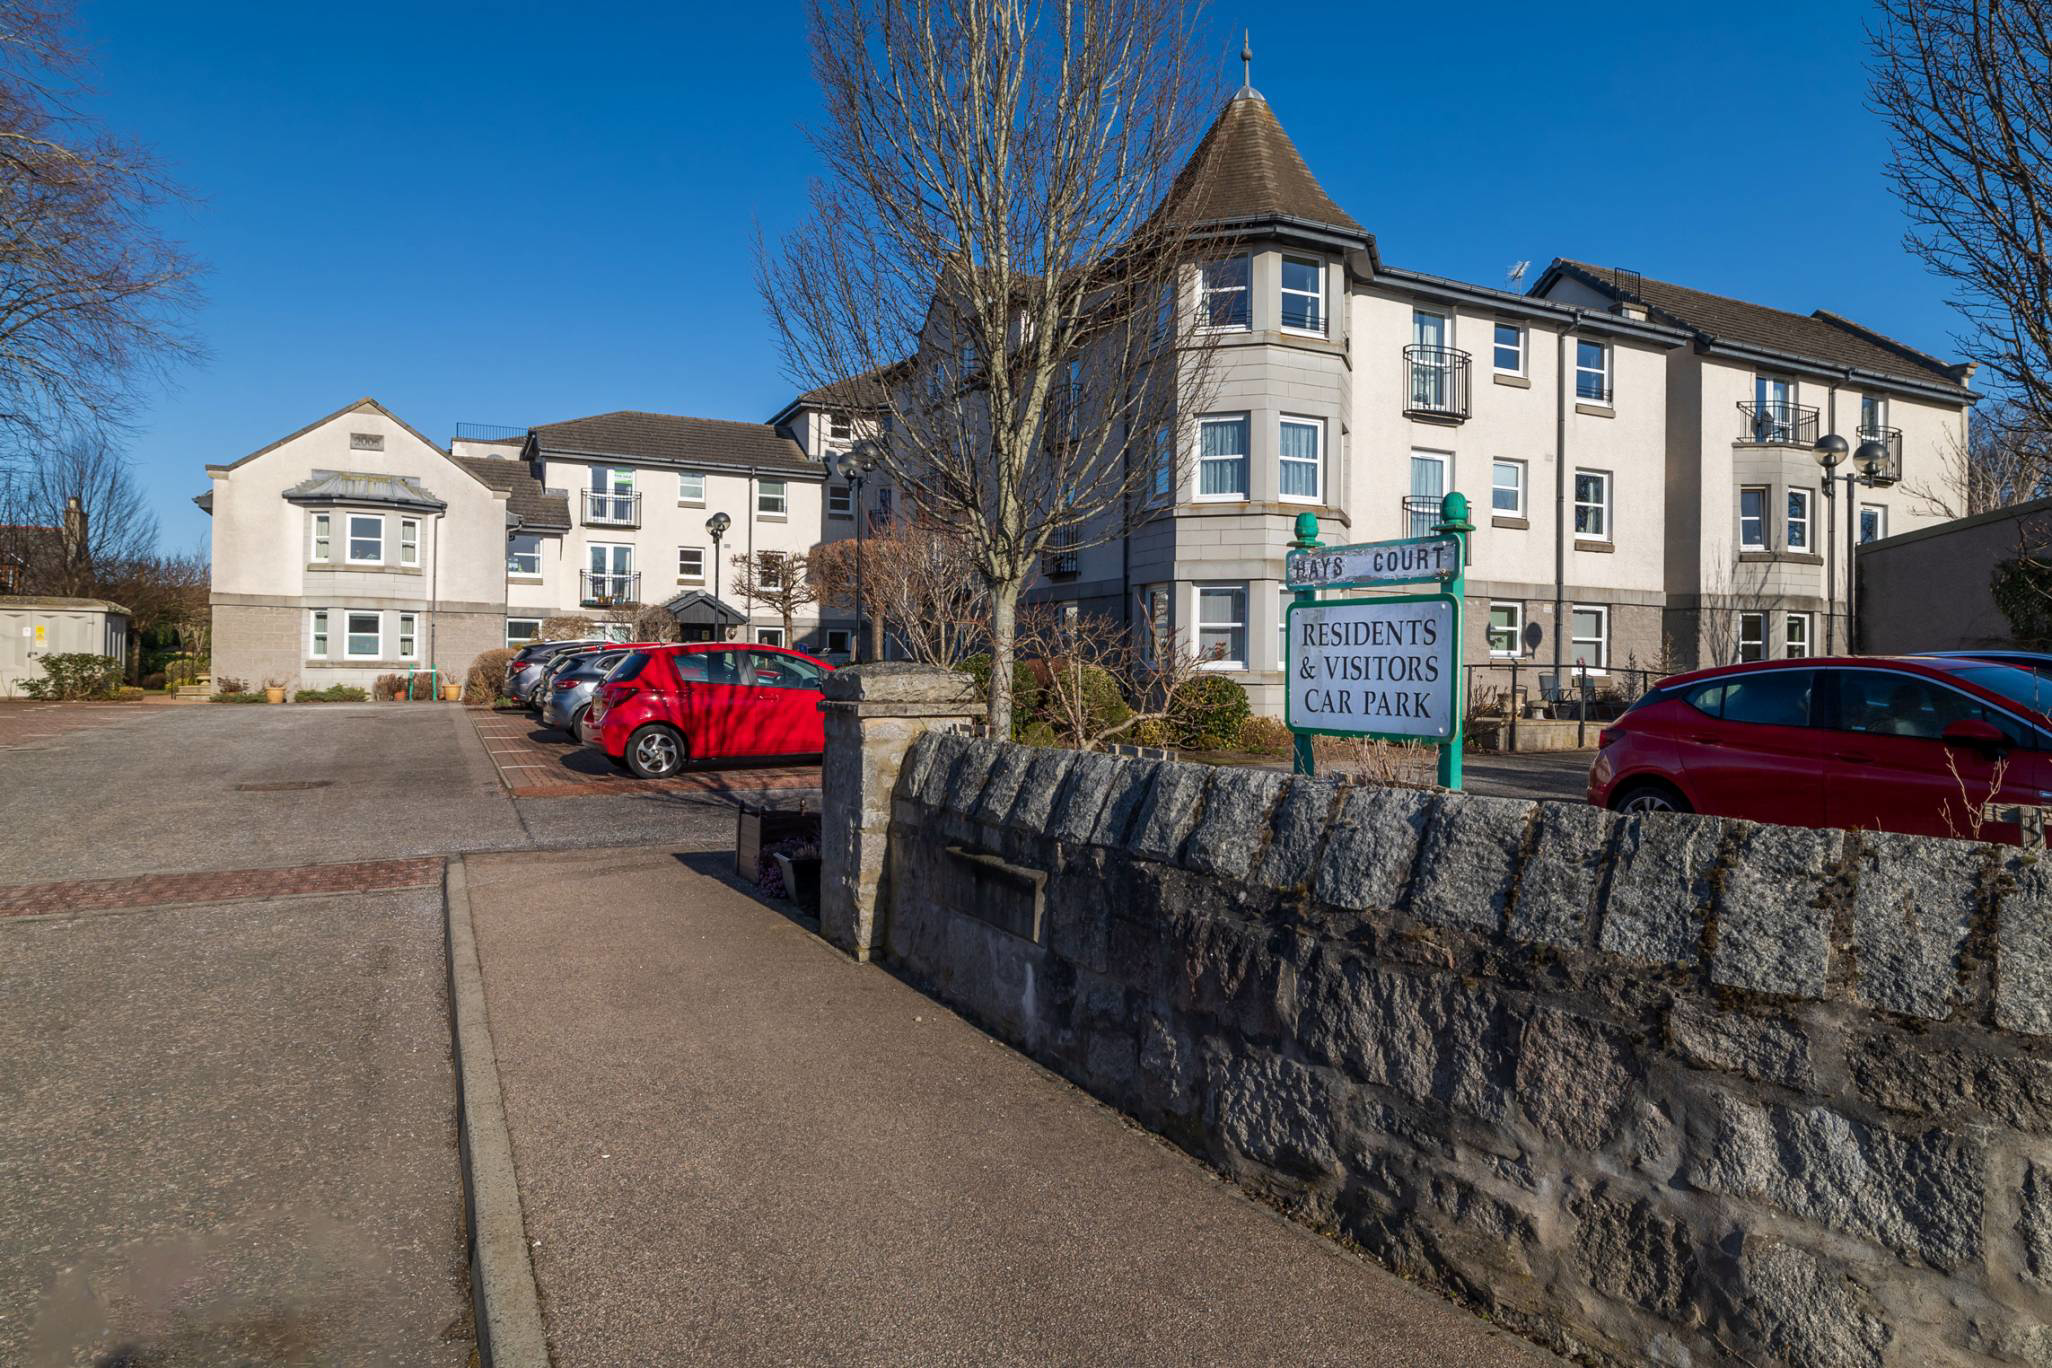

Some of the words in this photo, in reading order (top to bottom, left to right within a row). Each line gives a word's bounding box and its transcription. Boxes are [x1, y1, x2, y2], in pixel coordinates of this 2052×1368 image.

[1294, 557, 1343, 580] HAYS
[1373, 547, 1444, 572] COURT
[1302, 618, 1437, 647] RESIDENTS
[1300, 656, 1316, 680] &
[1324, 656, 1439, 682] VISITORS
[1304, 689, 1352, 714] CAR
[1362, 690, 1431, 718] PARK
